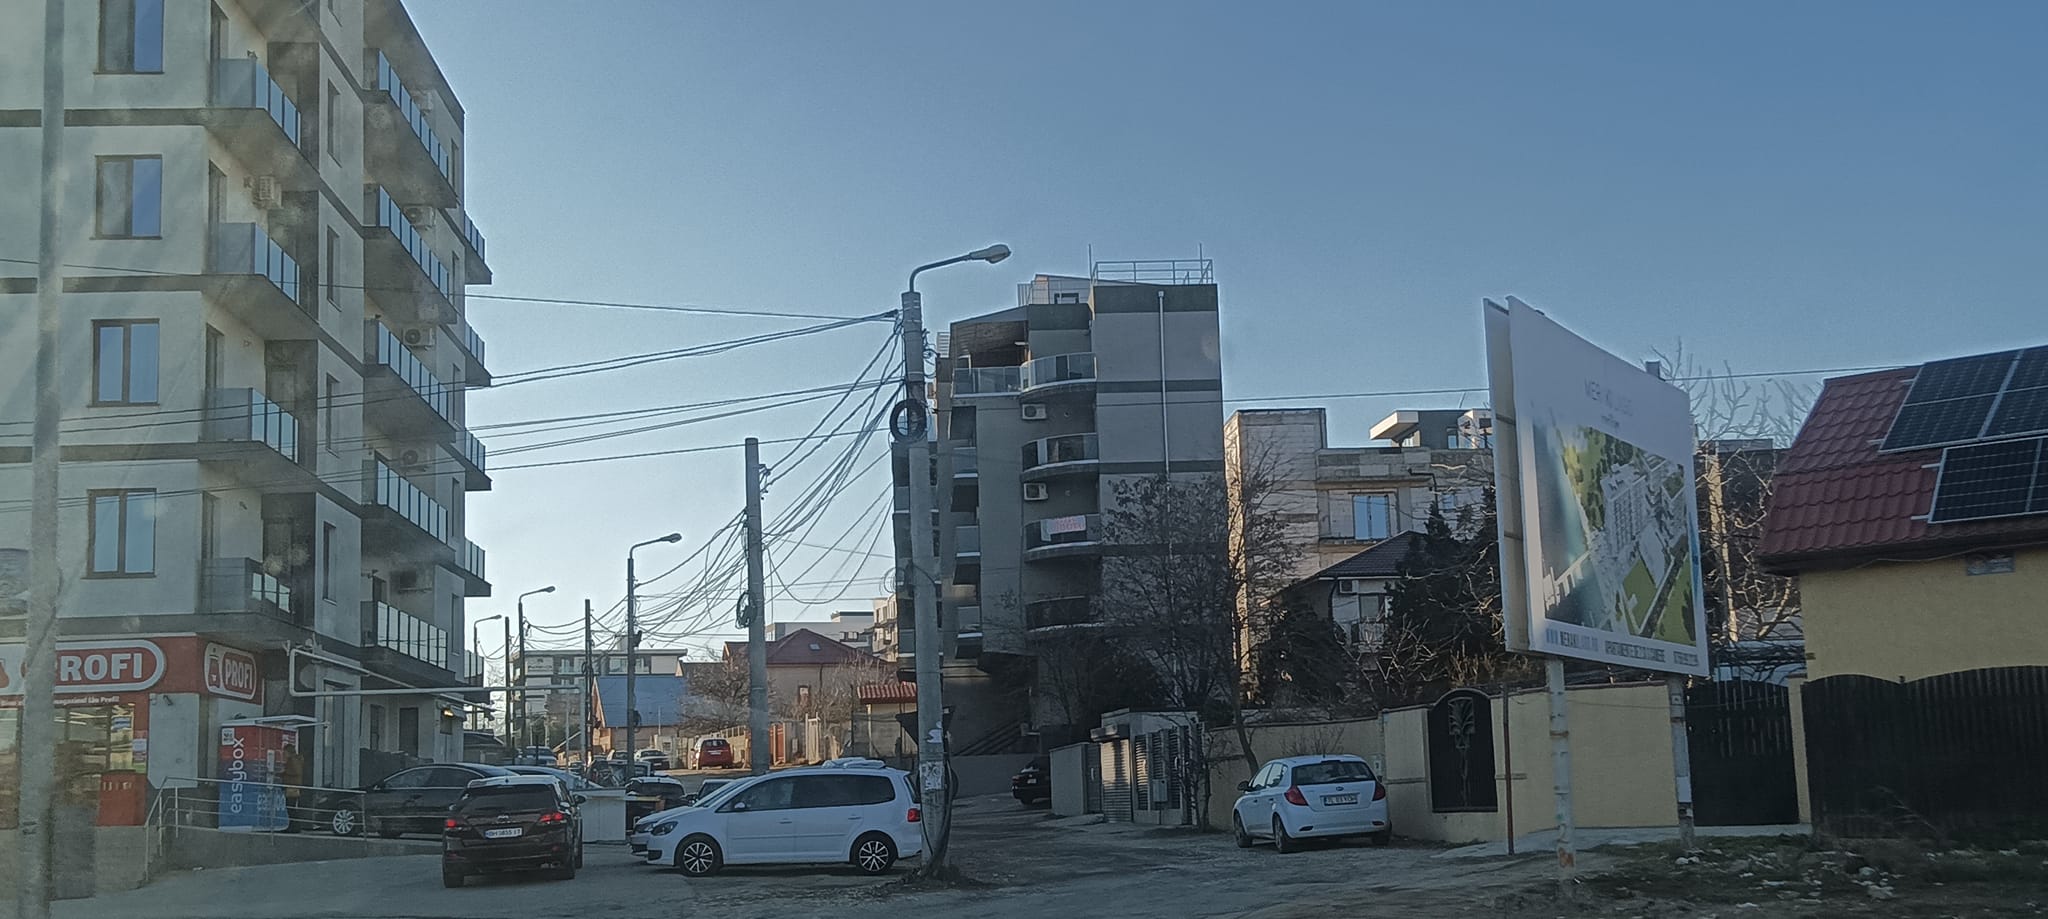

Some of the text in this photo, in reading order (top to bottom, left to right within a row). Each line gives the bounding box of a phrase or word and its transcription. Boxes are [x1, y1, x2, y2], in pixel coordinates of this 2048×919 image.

[56, 653, 142, 681] ROFI
[224, 657, 253, 690] PROFI
[228, 737, 247, 813] easybox
